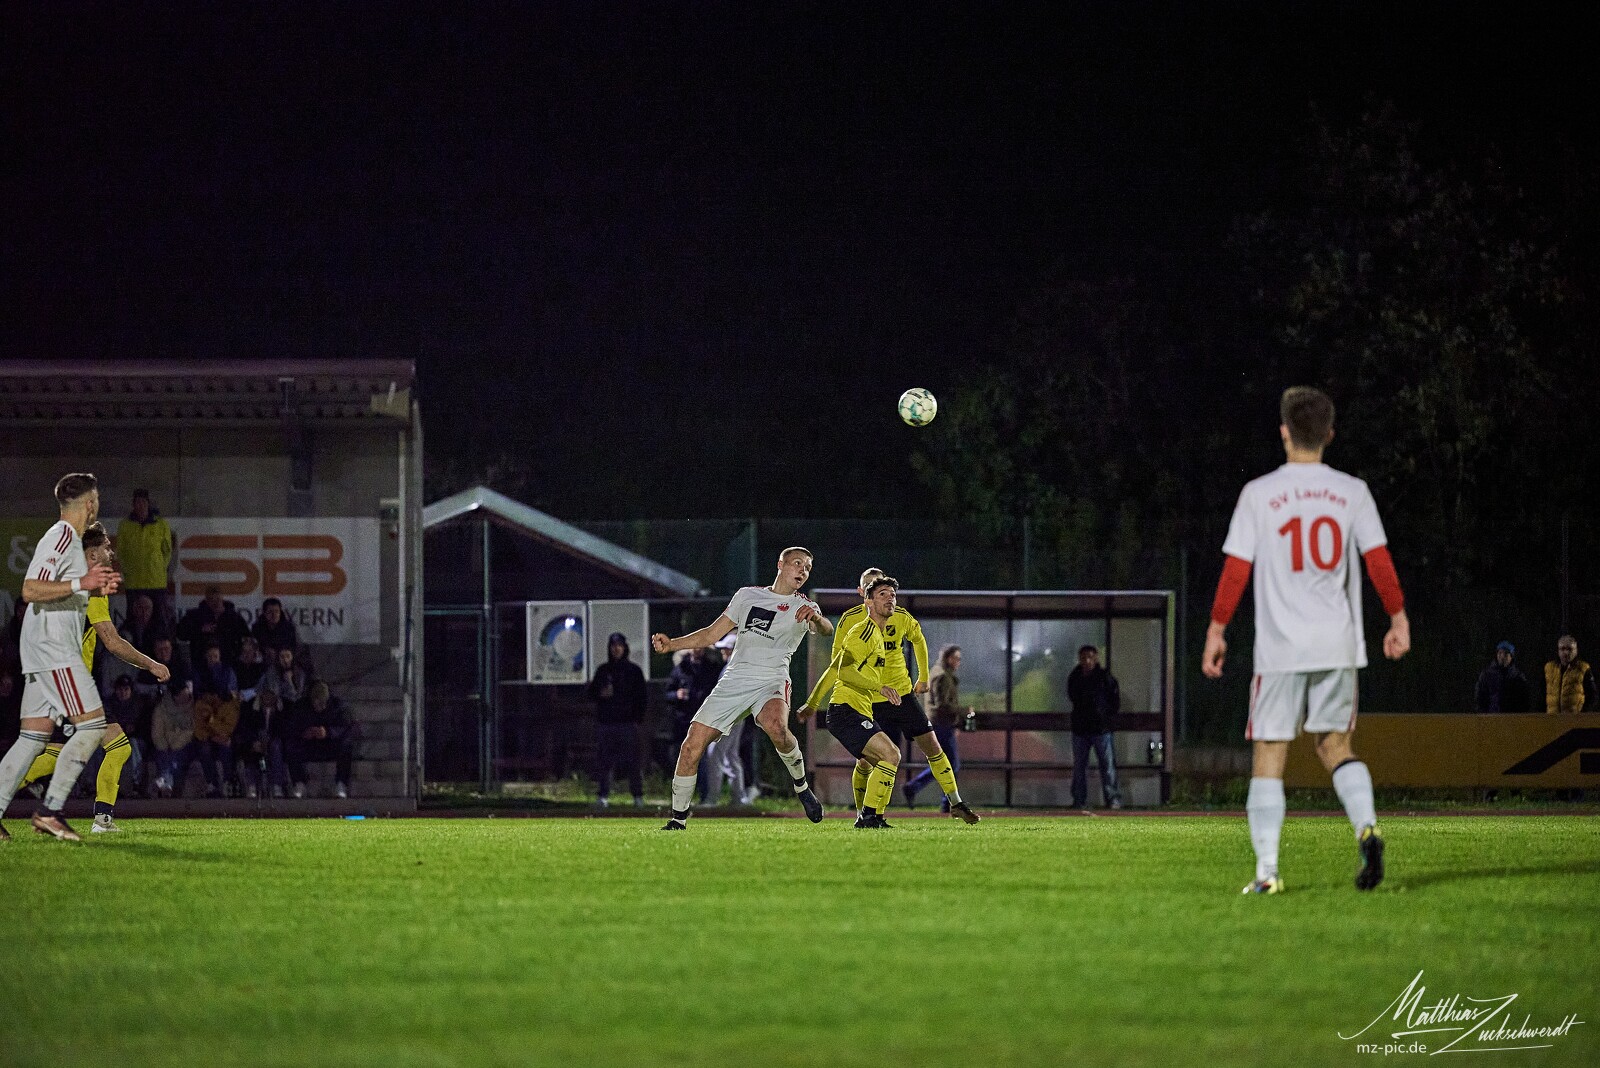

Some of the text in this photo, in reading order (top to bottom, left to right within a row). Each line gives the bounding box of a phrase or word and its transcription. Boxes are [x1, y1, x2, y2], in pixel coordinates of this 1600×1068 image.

[1269, 487, 1348, 511] SV Laufen
[1278, 515, 1343, 573] 10
